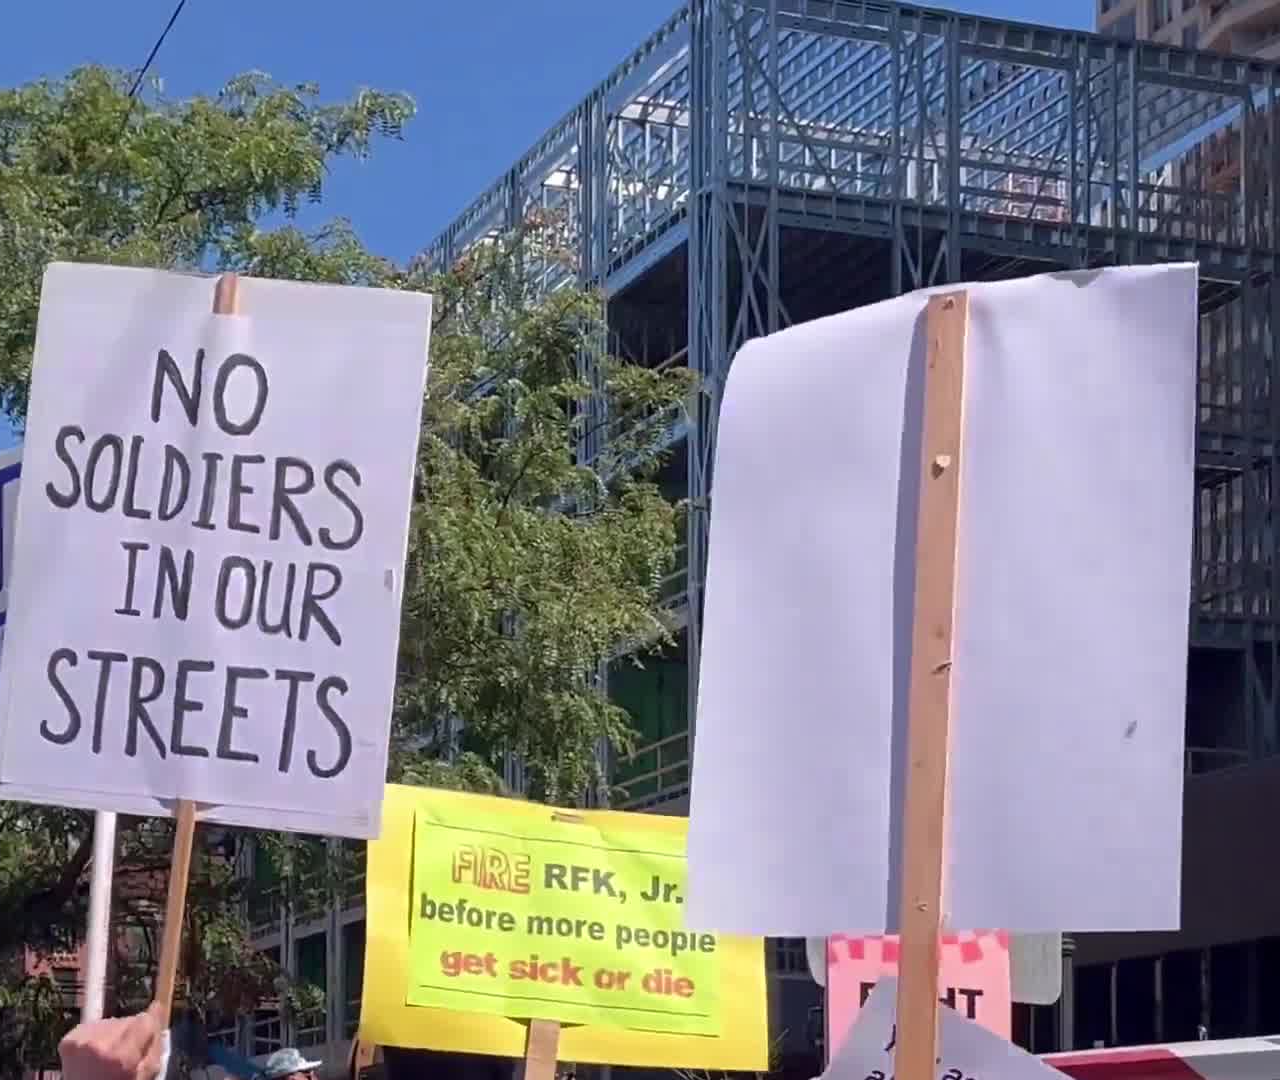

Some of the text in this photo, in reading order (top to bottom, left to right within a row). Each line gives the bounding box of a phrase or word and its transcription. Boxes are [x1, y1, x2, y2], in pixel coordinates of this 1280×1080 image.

[151, 348, 269, 436] NO
[45, 425, 364, 550] SOLDIERS
[114, 542, 343, 647] IN OUR
[40, 647, 353, 779] STREETS
[452, 844, 684, 904] FIRE RFK, Jr.
[420, 892, 716, 956] before more people
[440, 950, 695, 998] get sick or die
